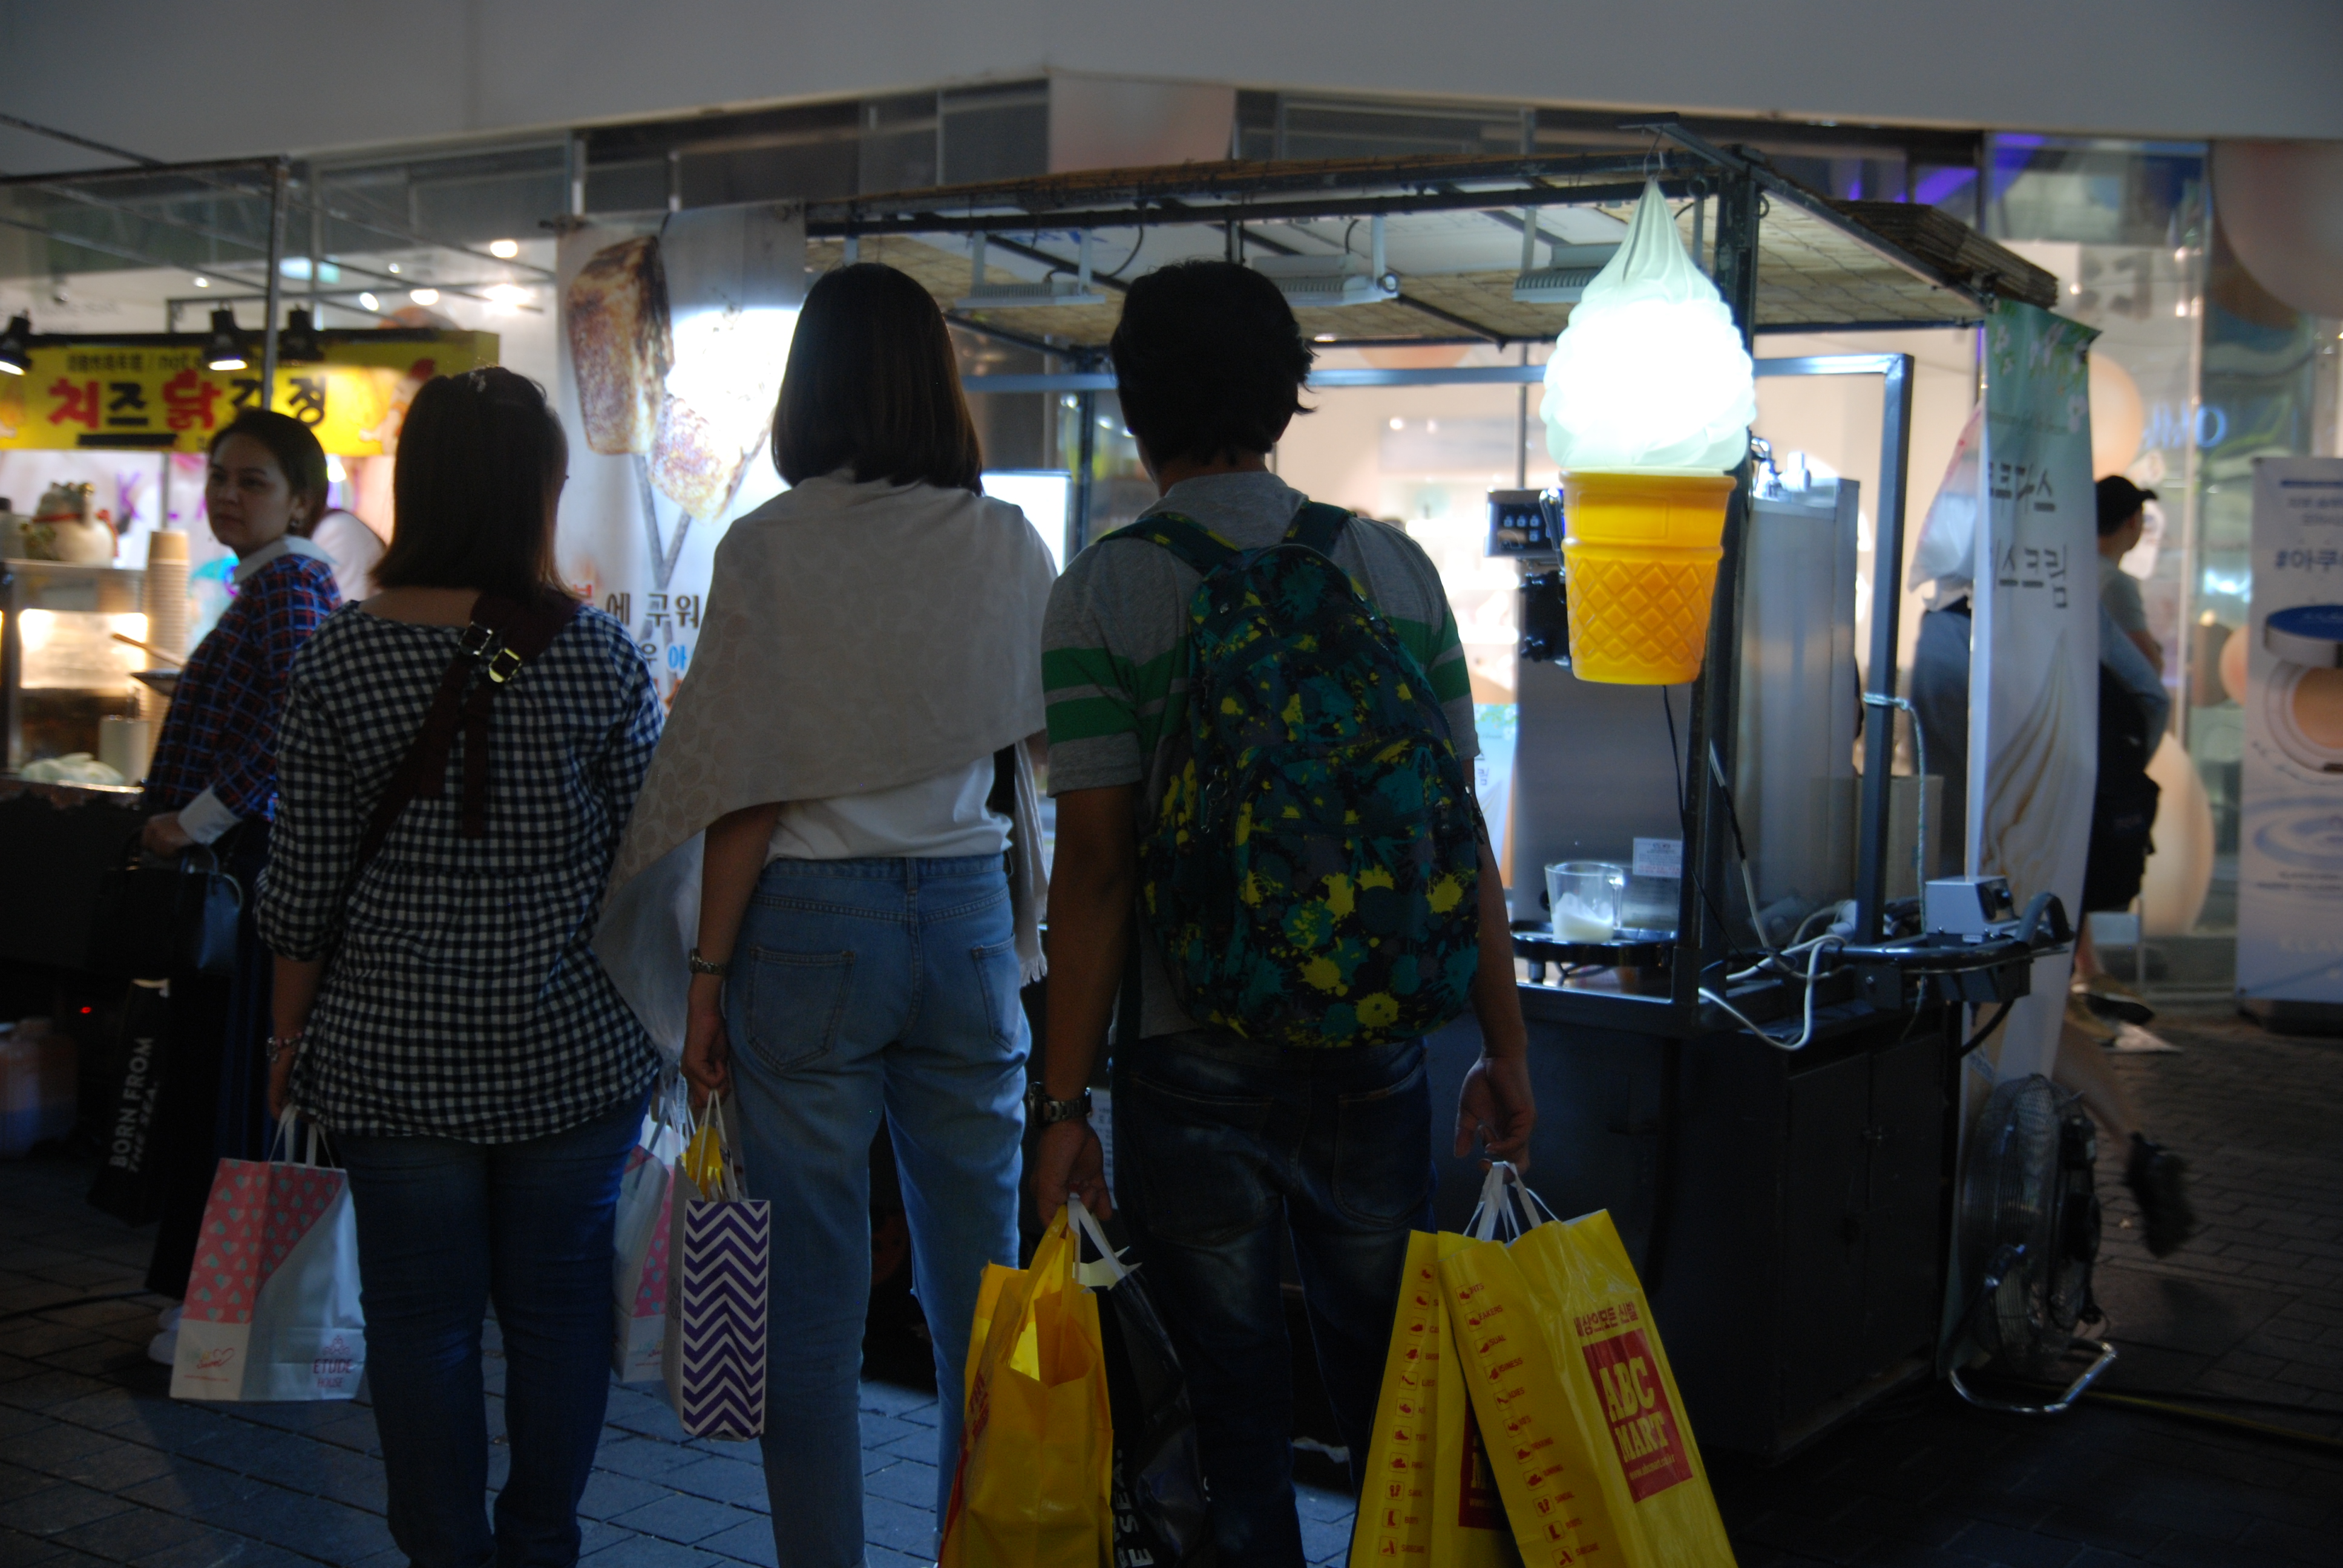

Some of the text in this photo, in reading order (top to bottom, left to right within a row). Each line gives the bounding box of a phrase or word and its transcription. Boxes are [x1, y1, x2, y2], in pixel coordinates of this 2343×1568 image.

[109, 1037, 154, 1168] BORN FROM
[313, 1359, 353, 1374] ETUDE
[1599, 1356, 1656, 1423] ABC
[1614, 1411, 1670, 1463] MART
